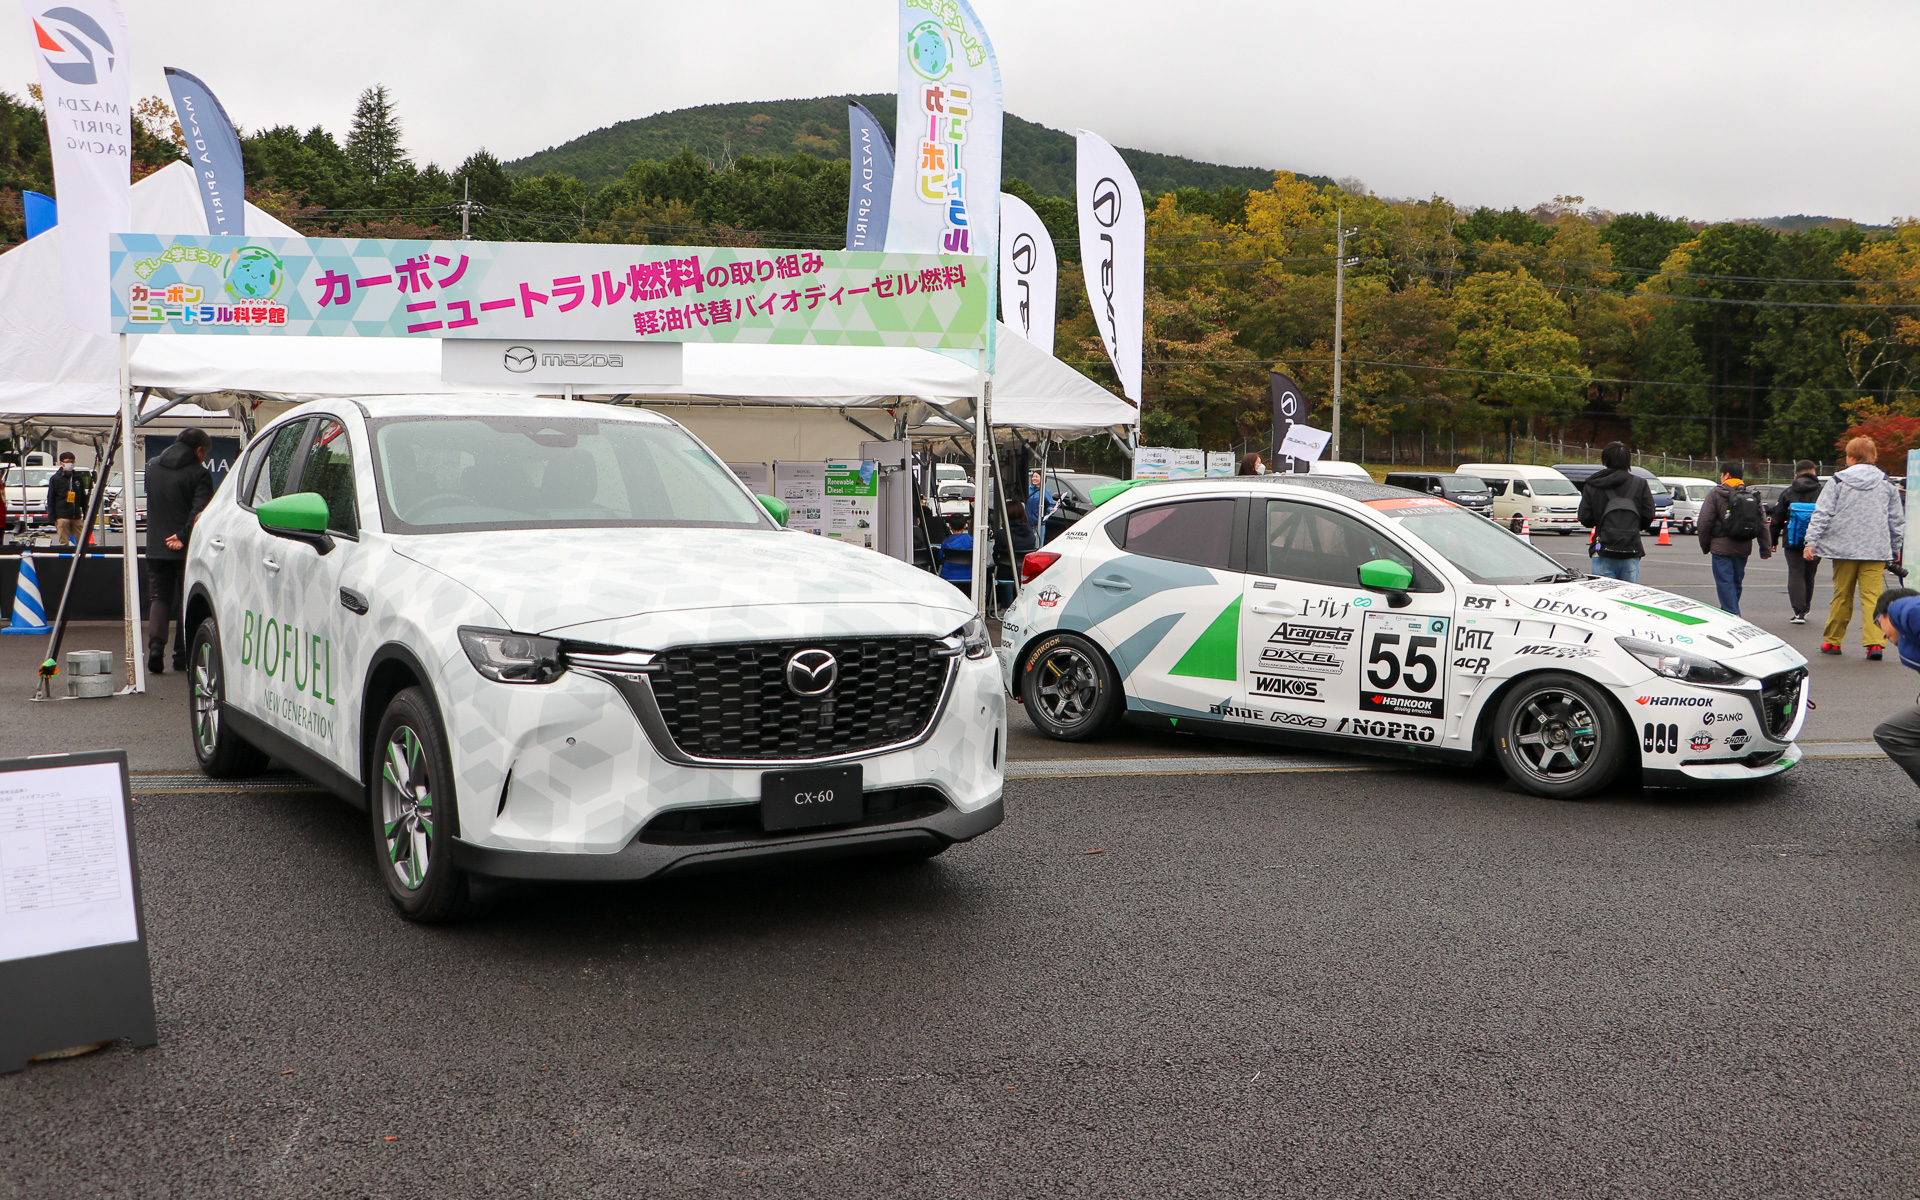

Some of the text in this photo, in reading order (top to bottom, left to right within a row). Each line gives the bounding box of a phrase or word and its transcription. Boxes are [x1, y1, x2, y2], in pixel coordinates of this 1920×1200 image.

[315, 253, 470, 308] カーボン
[132, 286, 201, 303] カーボン
[406, 252, 824, 334] ニュートラル燃料の取り組み
[633, 264, 967, 336] 軽油代替バイオディーゼル燃料
[132, 305, 285, 324] ニュートラル科学館
[202, 458, 235, 472] MA
[827, 478, 854, 486] Renewable
[1298, 597, 1351, 619] ユーグレナ
[1533, 597, 1608, 621] DENSO
[1269, 622, 1353, 645] Aragosta
[1431, 620, 1445, 633] Q
[242, 609, 335, 706] BIOFUEL
[1029, 637, 1060, 665] HANKOOK
[1262, 648, 1340, 664] DIXCEL
[1367, 632, 1437, 693] 55
[1453, 657, 1490, 674] 4CR
[1382, 696, 1432, 710] HANKOOK
[1649, 696, 1714, 707] HANKOOK
[264, 688, 334, 742] NEW GENERATION
[1209, 703, 1264, 720] BRIDE
[1270, 711, 1327, 728] RAYS
[1411, 707, 1432, 715] emotion
[1716, 712, 1743, 722] SANKO
[1352, 718, 1435, 743] NOPRO
[1645, 738, 1676, 747] HAL
[1723, 736, 1752, 745] SHORAI
[794, 789, 834, 805] CX-60
